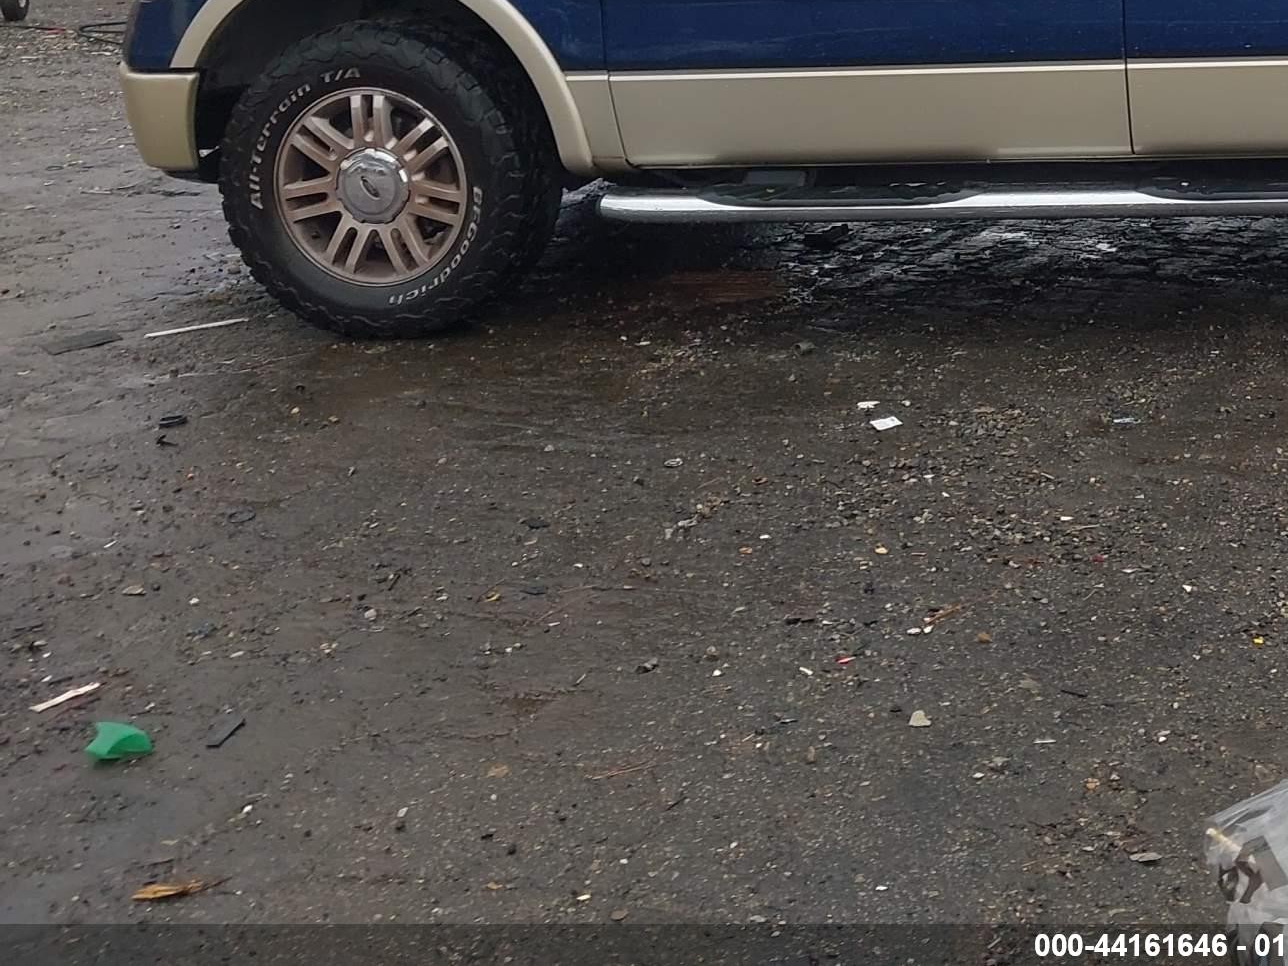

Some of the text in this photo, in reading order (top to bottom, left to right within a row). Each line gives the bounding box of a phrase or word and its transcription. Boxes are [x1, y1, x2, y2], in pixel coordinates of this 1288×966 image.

[249, 67, 361, 210] All-Terrain T/A
[389, 186, 483, 305] BFGoodrich
